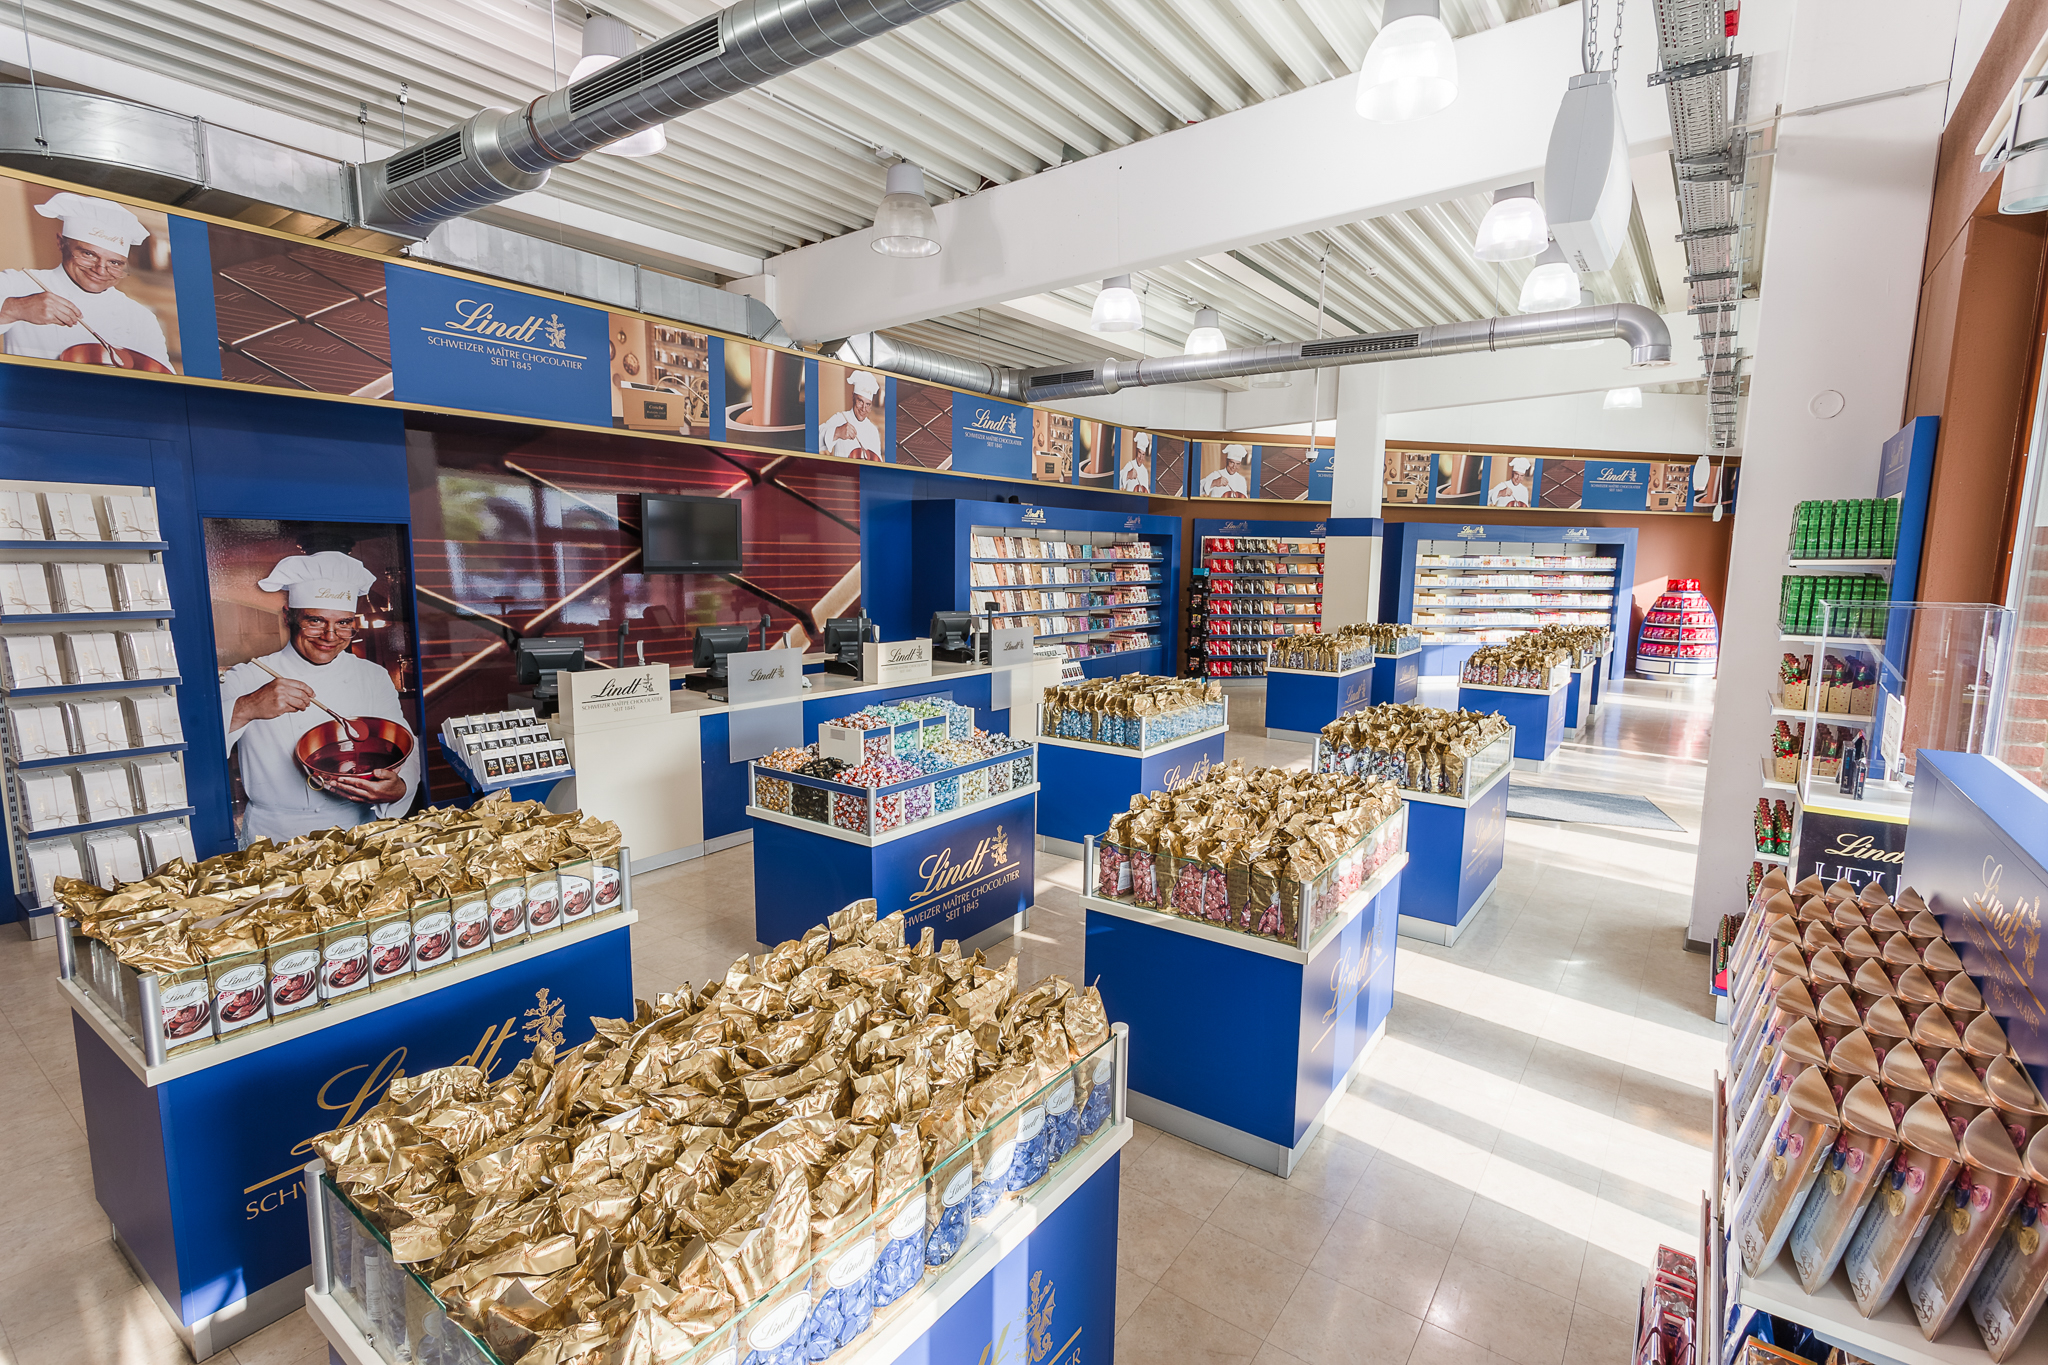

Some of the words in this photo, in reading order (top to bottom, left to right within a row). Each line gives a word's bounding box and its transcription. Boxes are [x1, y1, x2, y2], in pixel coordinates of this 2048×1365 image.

[239, 261, 313, 282] Lindt
[445, 299, 544, 343] Lindt
[264, 335, 344, 355] Lindt
[427, 336, 484, 354] SCHWEIZER
[486, 346, 520, 360] MAÎTRE
[522, 353, 583, 371] CHOCOLATIER
[491, 356, 509, 368] SEIT
[511, 359, 532, 372] 1845
[971, 408, 1008, 431] Lindt
[1597, 467, 1630, 481] Lindt
[315, 588, 345, 600] Lindt
[1003, 641, 1020, 651] Lindt
[887, 647, 916, 663] Lindt
[748, 668, 777, 682] Lindt
[590, 677, 642, 699] Lindt
[581, 701, 610, 711] SCHWEIZER
[630, 696, 663, 705] CHOCOLATIER
[909, 837, 991, 902] Lindt
[494, 892, 518, 905] Lindt
[904, 904, 940, 929] HWEIZER
[942, 890, 970, 912] MAÎTRE
[971, 869, 1020, 898] CHOCOLATIER
[1973, 855, 2029, 950] Lindt
[457, 905, 481, 919] Lindt
[945, 906, 960, 922] SEIT
[962, 899, 979, 914] 1845
[417, 917, 443, 931] Lindt
[375, 927, 402, 941] Lindt
[329, 942, 358, 957] Lindt
[277, 955, 309, 971] Lindt
[221, 970, 255, 987] Lindt
[1322, 926, 1375, 1024] Lindt
[165, 986, 198, 1004] Lindt
[835, 1248, 868, 1279] Lindt
[758, 1304, 798, 1343] Lindt
